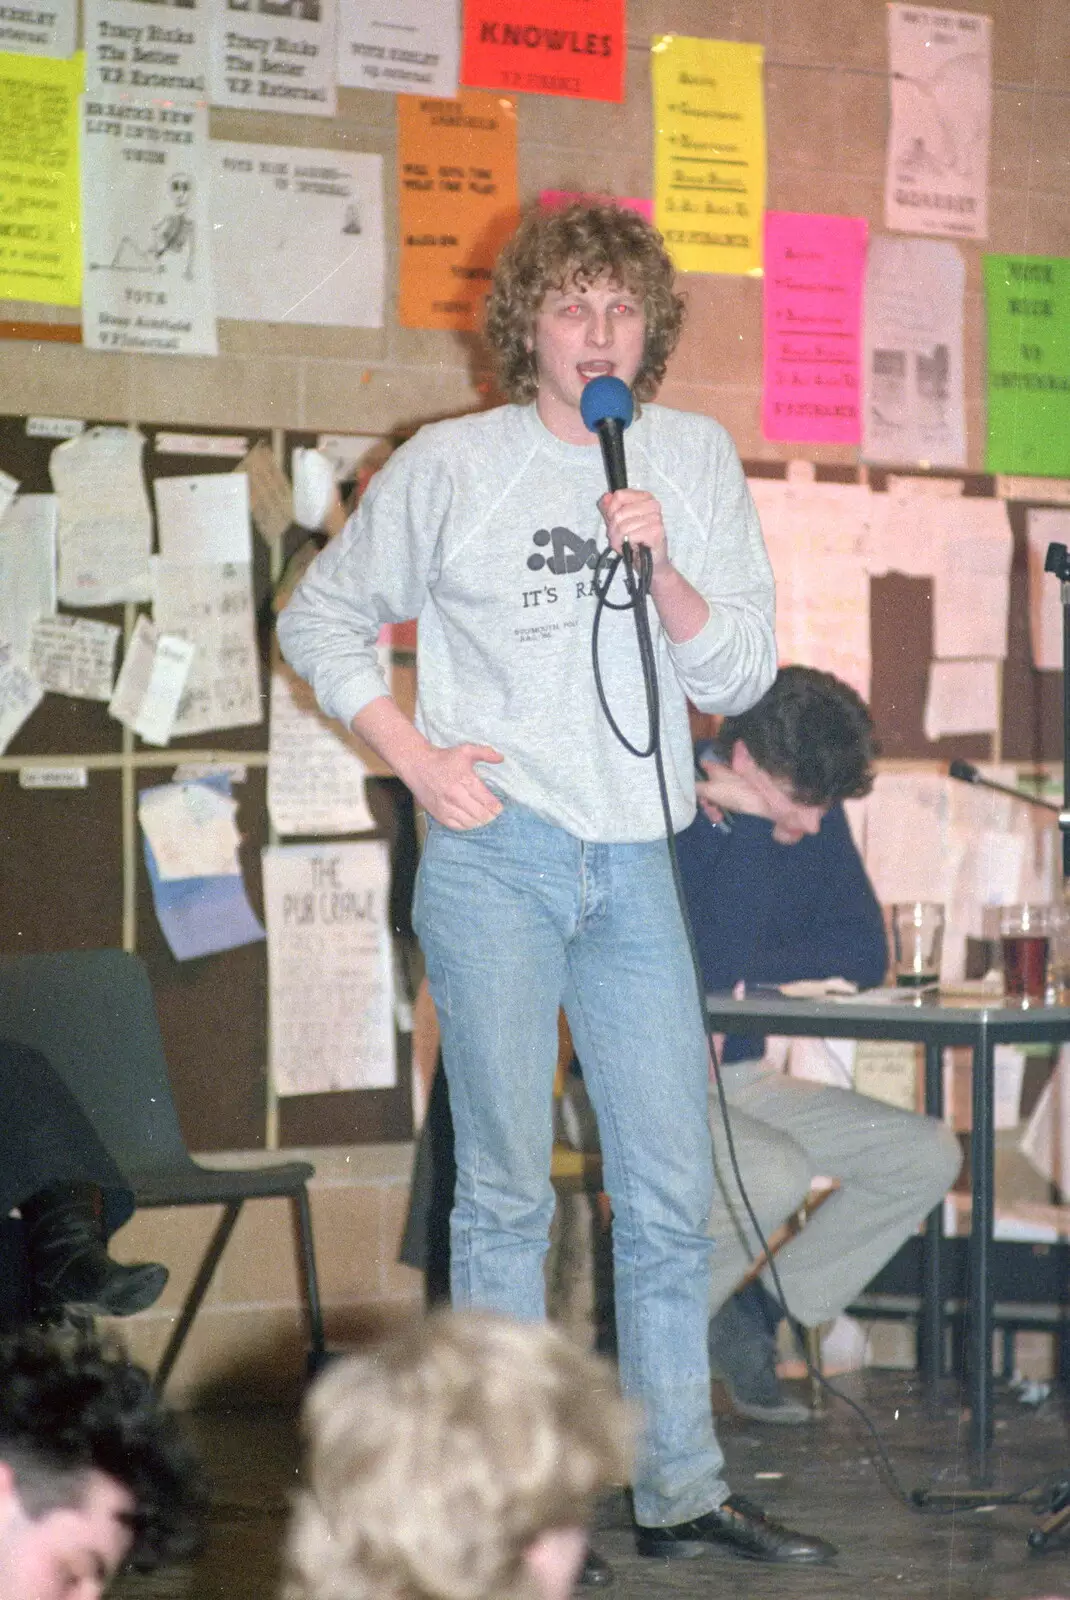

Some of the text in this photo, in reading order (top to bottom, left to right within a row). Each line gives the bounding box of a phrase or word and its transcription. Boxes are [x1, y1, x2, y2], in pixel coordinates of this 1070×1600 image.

[480, 21, 613, 58] KNOWLES
[131, 69, 205, 91] External
[258, 80, 328, 104] External
[522, 585, 558, 608] IT'S
